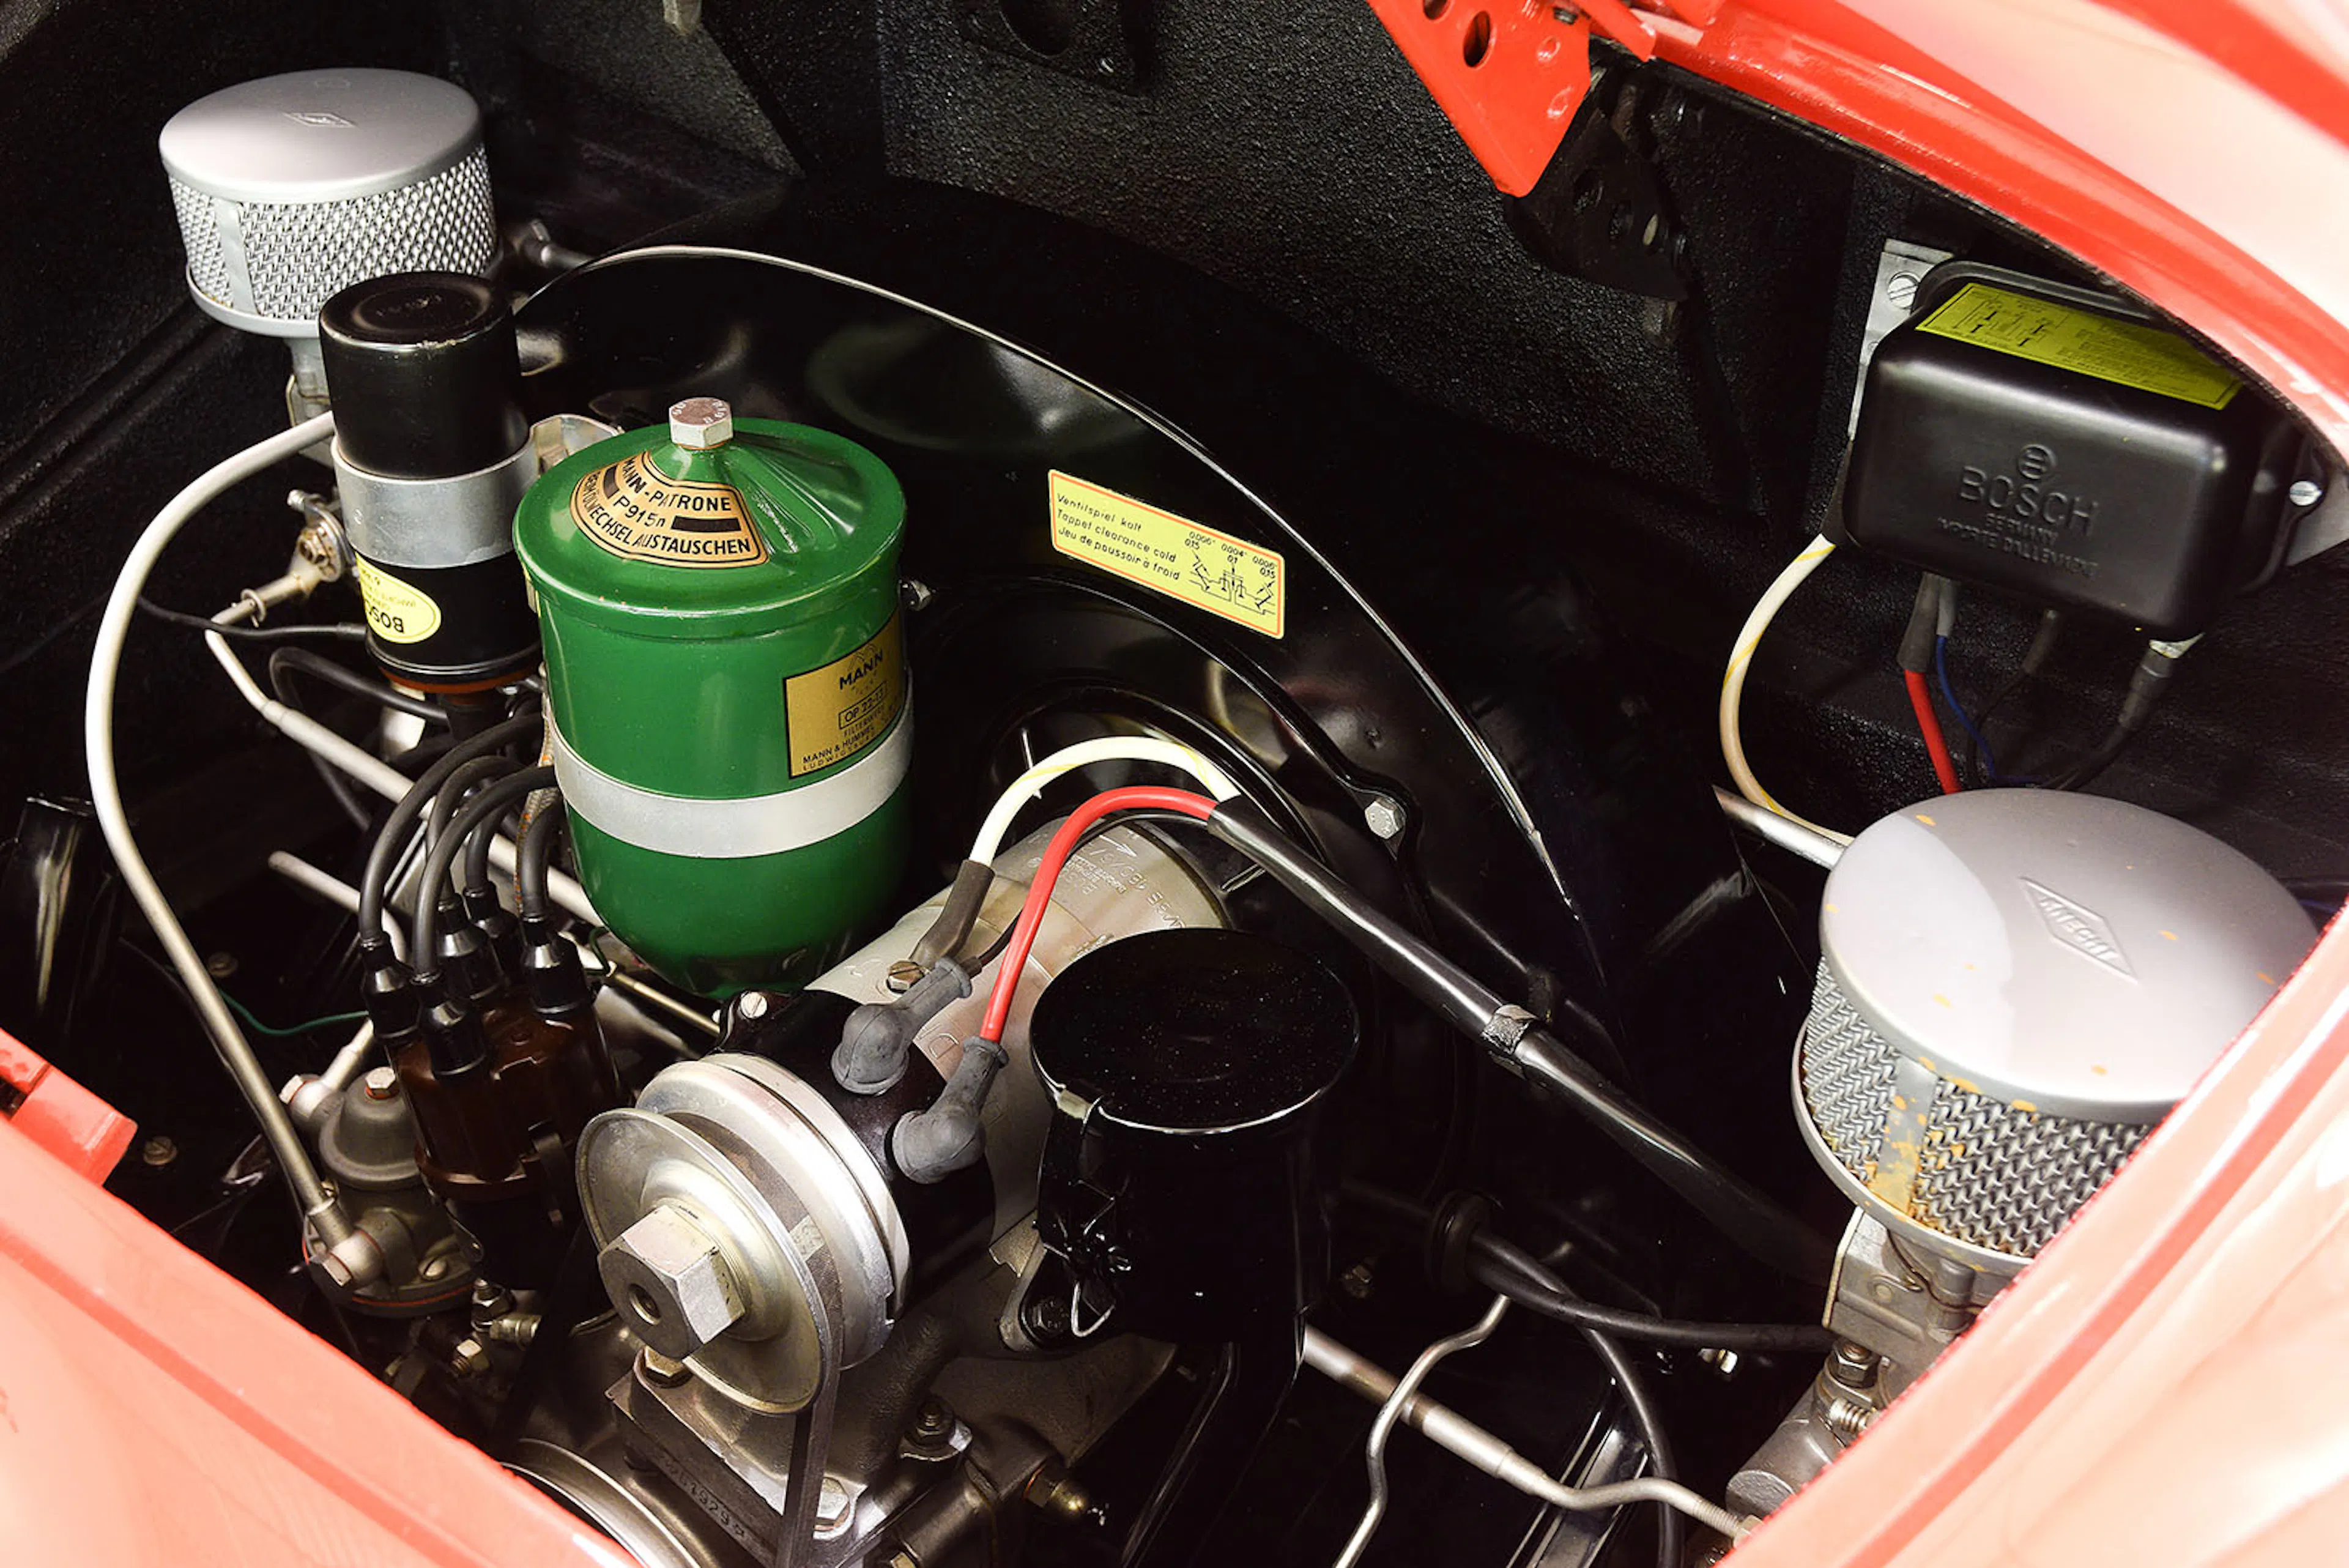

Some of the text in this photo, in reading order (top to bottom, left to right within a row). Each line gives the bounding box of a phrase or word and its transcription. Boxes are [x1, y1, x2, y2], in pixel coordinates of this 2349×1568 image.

[1959, 465, 2099, 535] BOSCH
[1058, 526, 1077, 540] Jeu
[1080, 534, 1093, 546] de
[1152, 562, 1181, 581] froid
[1095, 524, 1150, 551] clearance
[1153, 548, 1176, 563] cold
[839, 649, 883, 690] MANN
[803, 746, 833, 764] MANN
